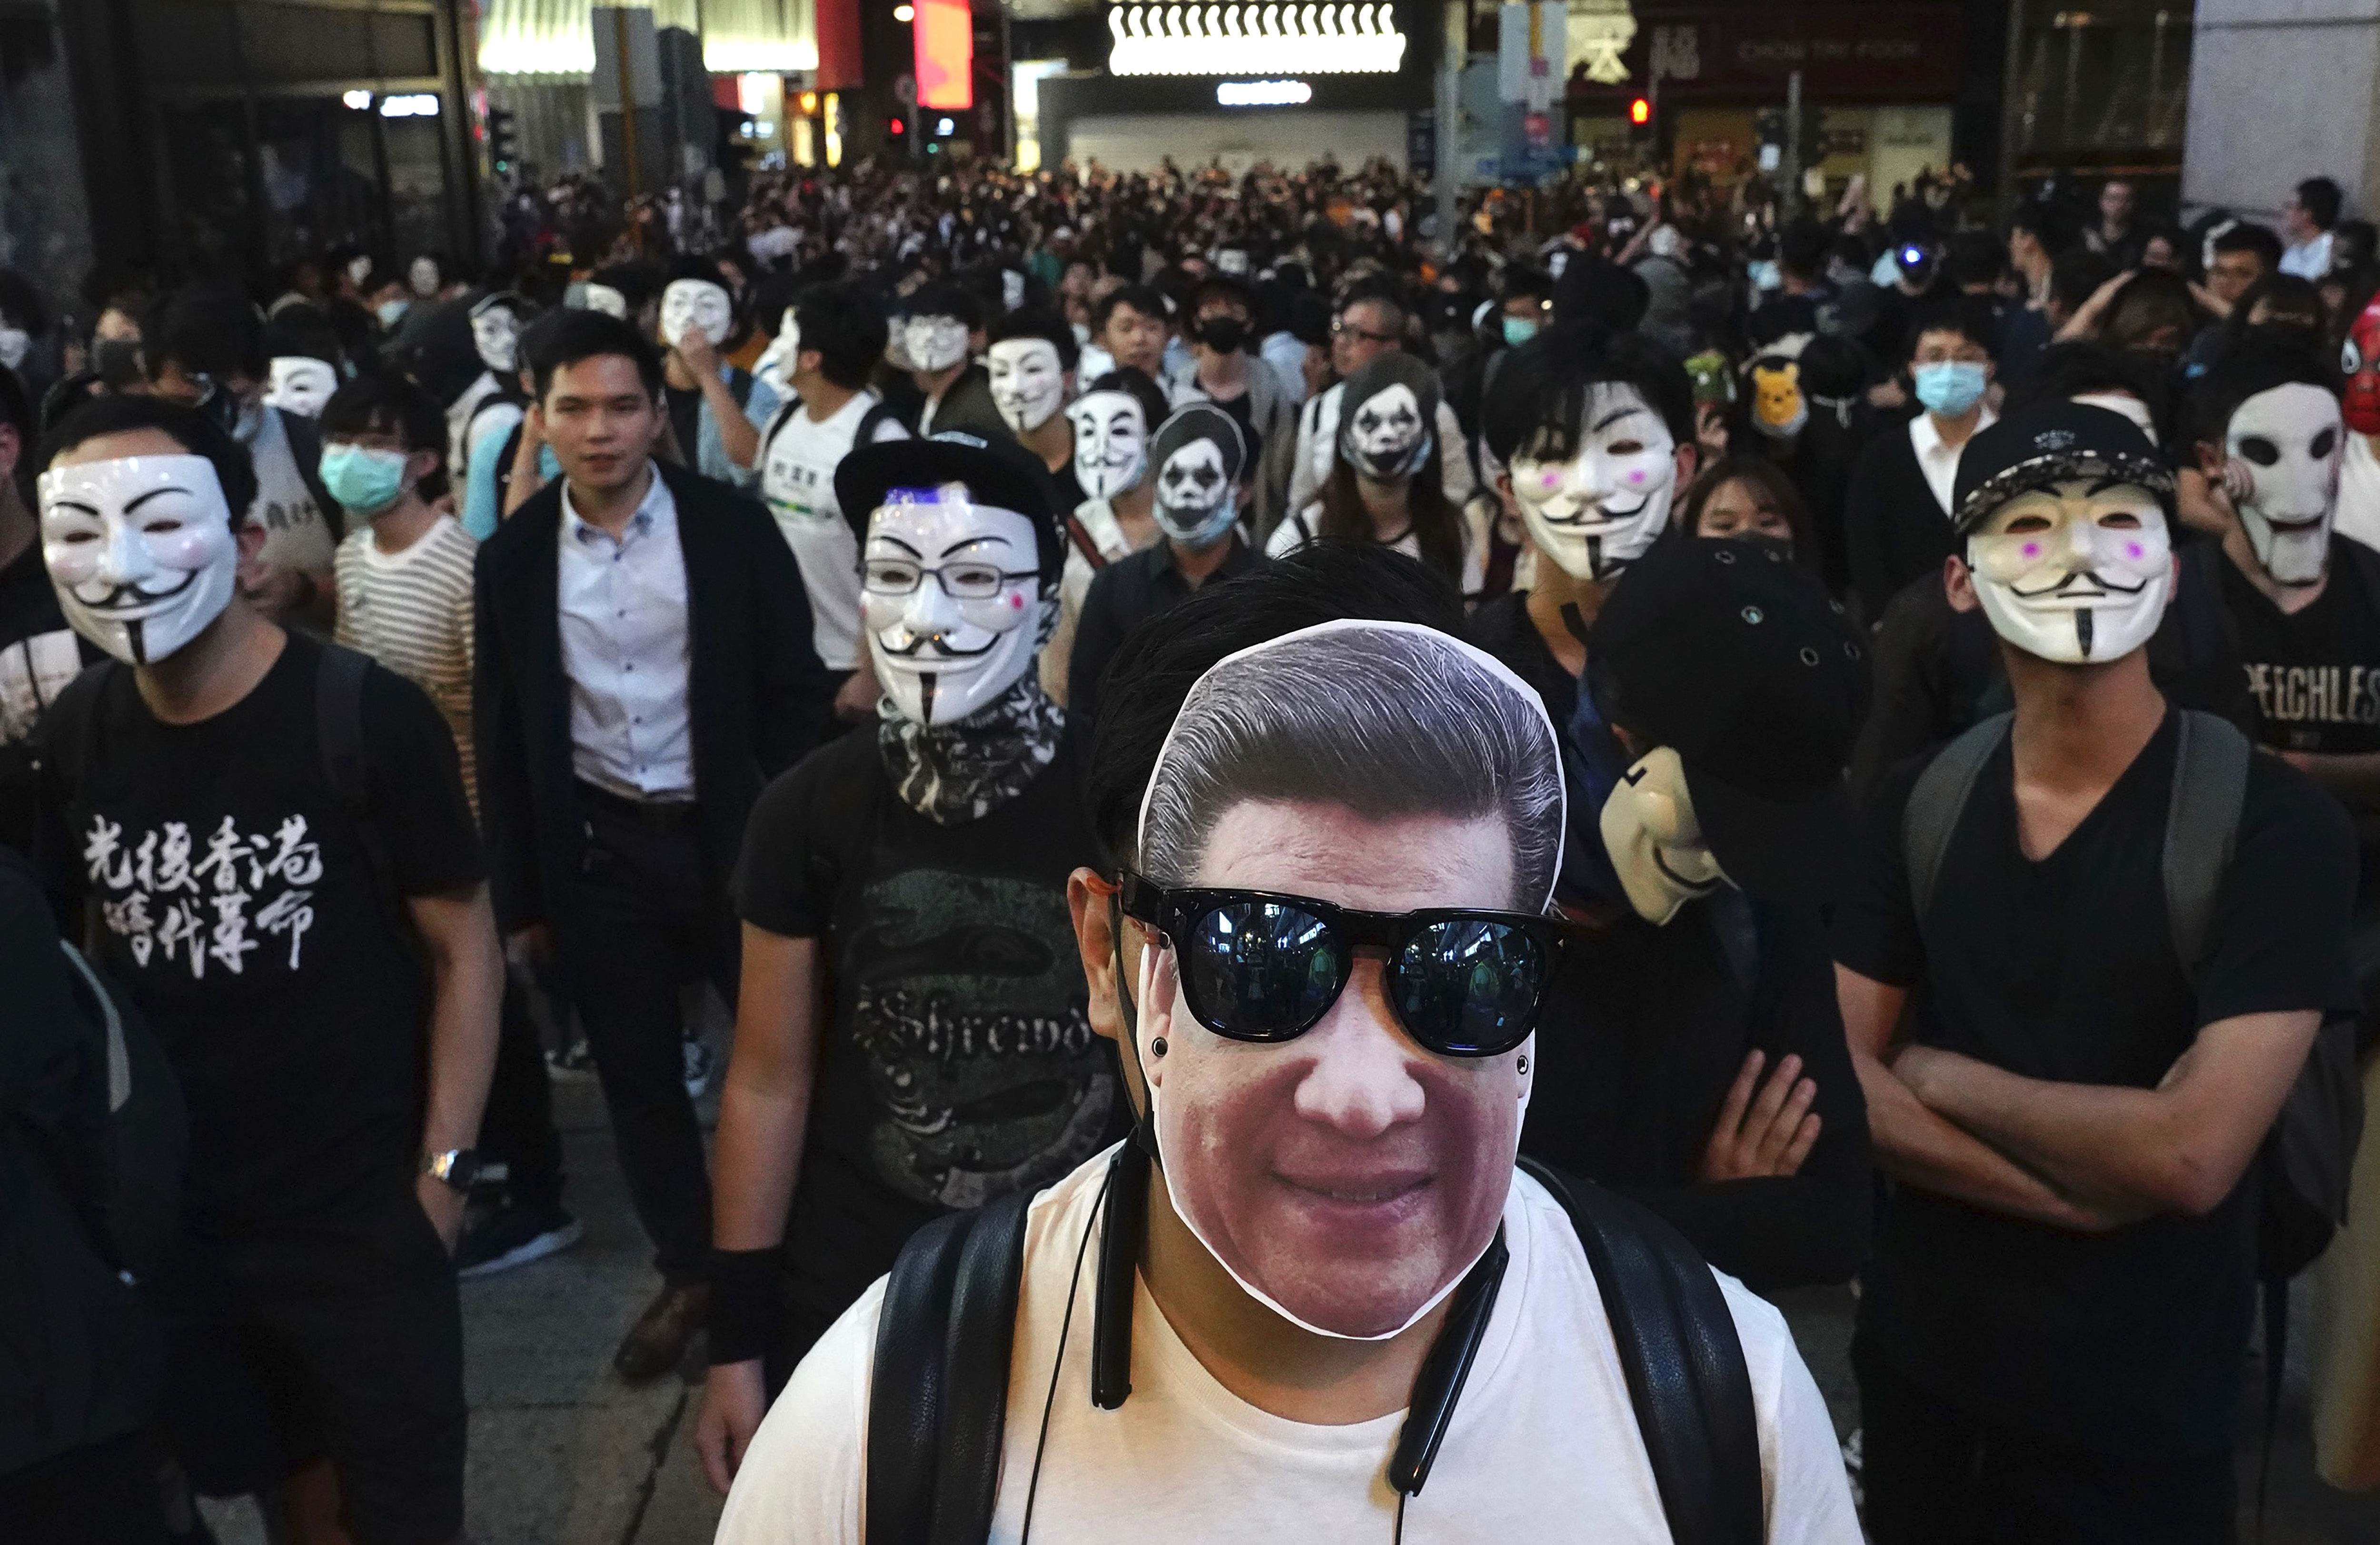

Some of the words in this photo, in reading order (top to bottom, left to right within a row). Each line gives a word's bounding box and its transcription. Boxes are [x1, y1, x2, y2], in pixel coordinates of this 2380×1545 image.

[84, 813, 324, 893] 光復香港
[102, 884, 315, 979] 時代革命
[880, 990, 1091, 1062] Shrewd
